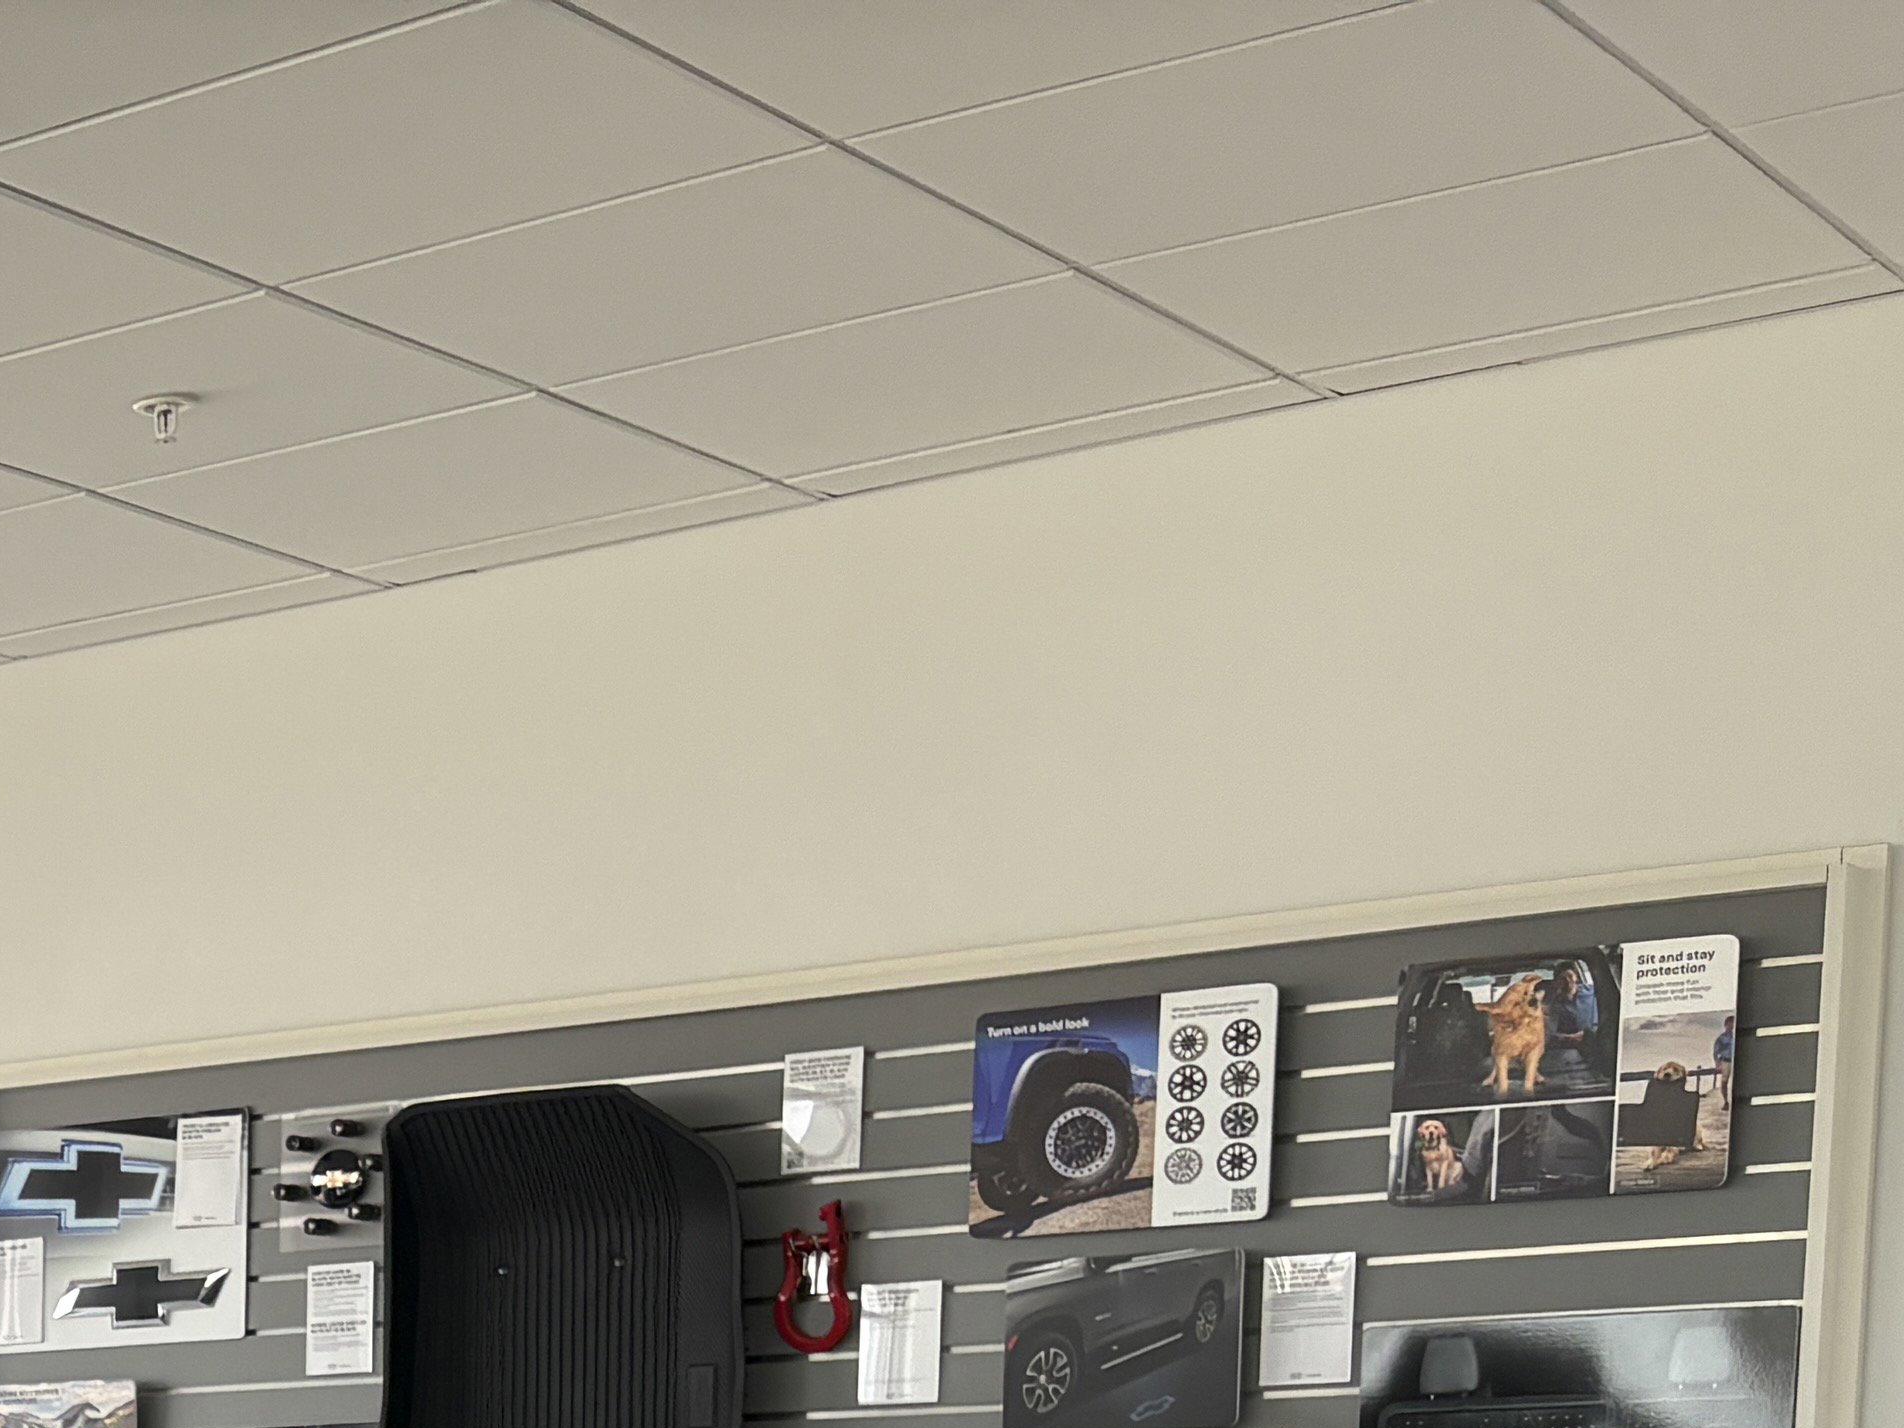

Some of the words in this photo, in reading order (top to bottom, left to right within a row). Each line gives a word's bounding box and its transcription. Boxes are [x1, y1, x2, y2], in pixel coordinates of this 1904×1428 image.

[1637, 954, 1656, 965] Sit
[1659, 951, 1683, 963] and
[1687, 950, 1715, 962] stay
[1636, 963, 1706, 980] protection
[987, 1026, 1011, 1038] Turn
[1013, 1025, 1028, 1035] on
[1029, 1024, 1037, 1034] a
[1038, 1019, 1064, 1032] bold
[1065, 1017, 1090, 1030] look
